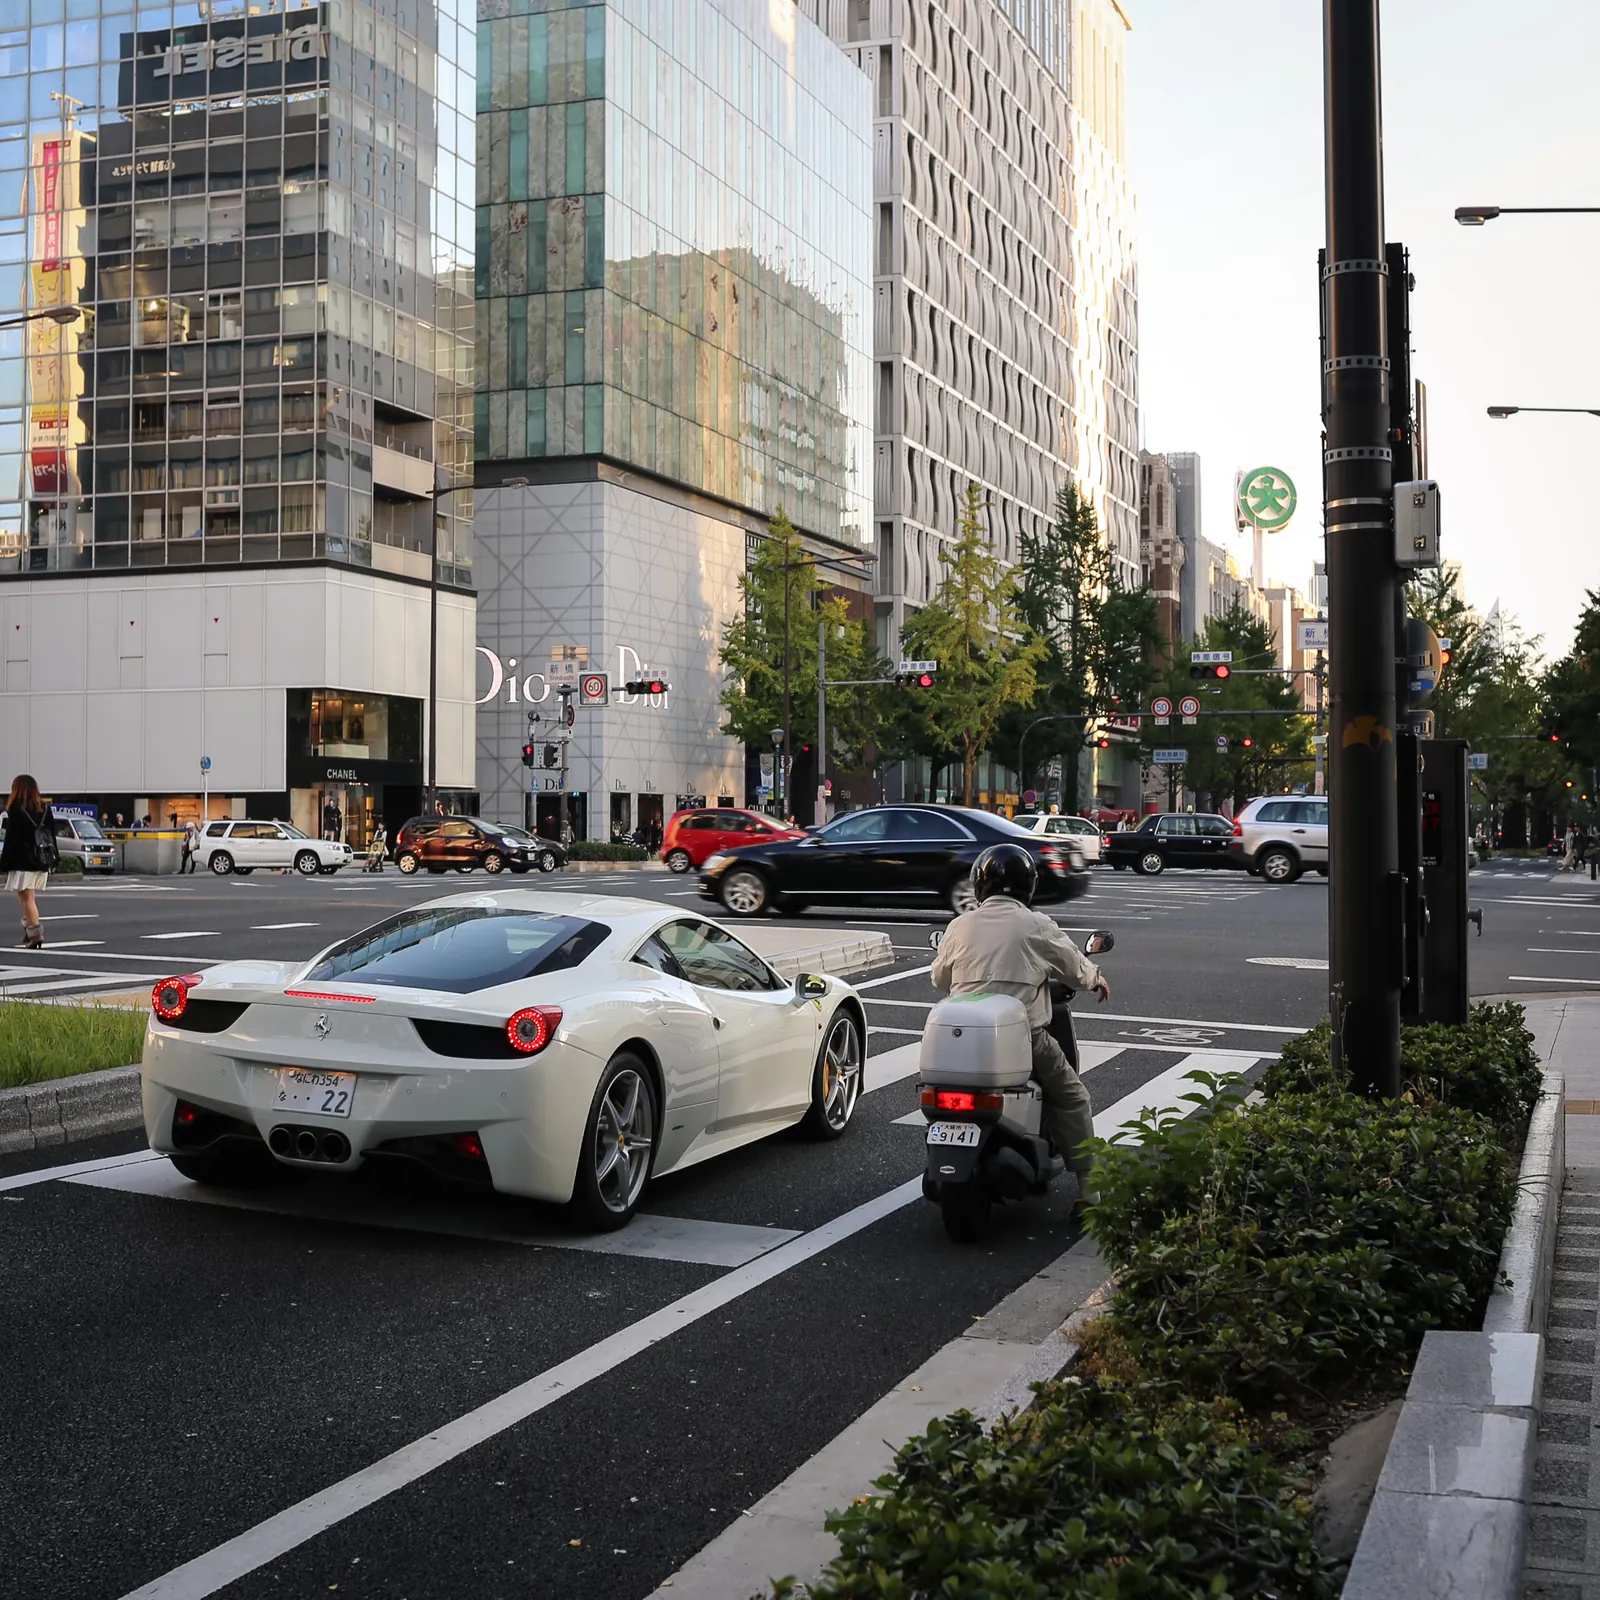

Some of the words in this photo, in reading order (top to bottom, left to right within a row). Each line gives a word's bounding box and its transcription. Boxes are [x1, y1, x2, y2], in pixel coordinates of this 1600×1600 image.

[1193, 653, 1230, 661] 時差信号
[476, 646, 563, 703] Dio
[588, 682, 600, 692] 60
[1156, 703, 1168, 712] 50
[1184, 702, 1195, 712] 60
[326, 769, 357, 780] CHANEL
[319, 1074, 339, 1087] 354
[321, 1089, 348, 1113] 22
[940, 1131, 974, 1144] 9141
